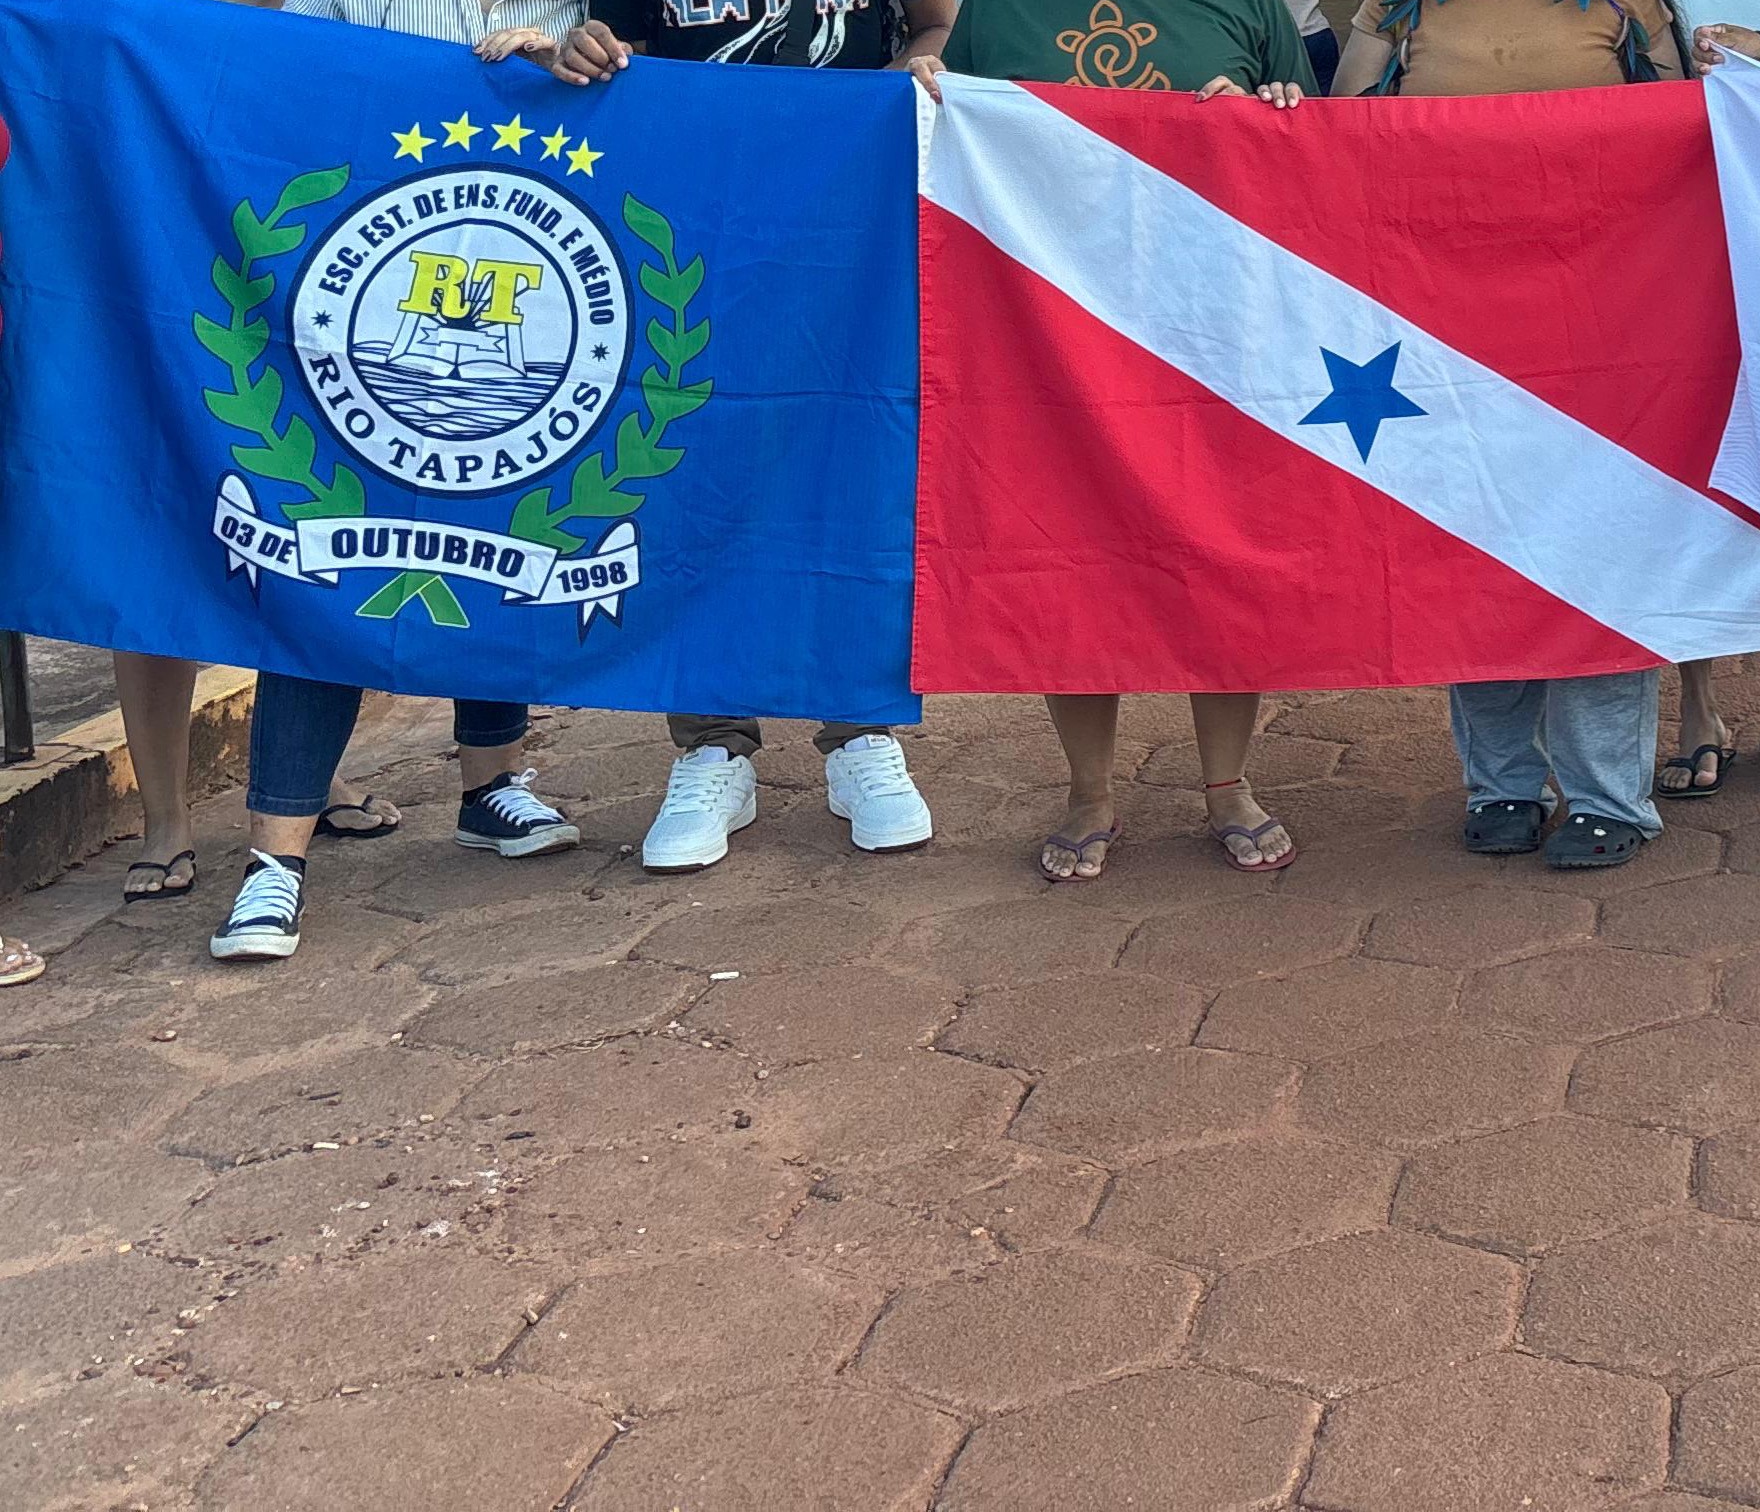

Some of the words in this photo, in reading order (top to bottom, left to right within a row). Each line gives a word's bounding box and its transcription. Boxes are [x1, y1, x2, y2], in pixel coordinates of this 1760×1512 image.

[413, 189, 448, 221] DE
[453, 184, 499, 210] ENS.
[504, 188, 565, 239] FUND.
[358, 204, 415, 248] EST.
[558, 227, 582, 251] E
[319, 245, 370, 296] ESC.
[398, 251, 543, 324] RT
[569, 244, 614, 326] MÉDIO
[308, 352, 376, 438] RIO
[387, 380, 602, 483] TAPAJÓS
[219, 513, 257, 549] 03
[262, 533, 293, 564] DE
[330, 526, 526, 579] OUTUBRO
[556, 559, 629, 595] 1998
